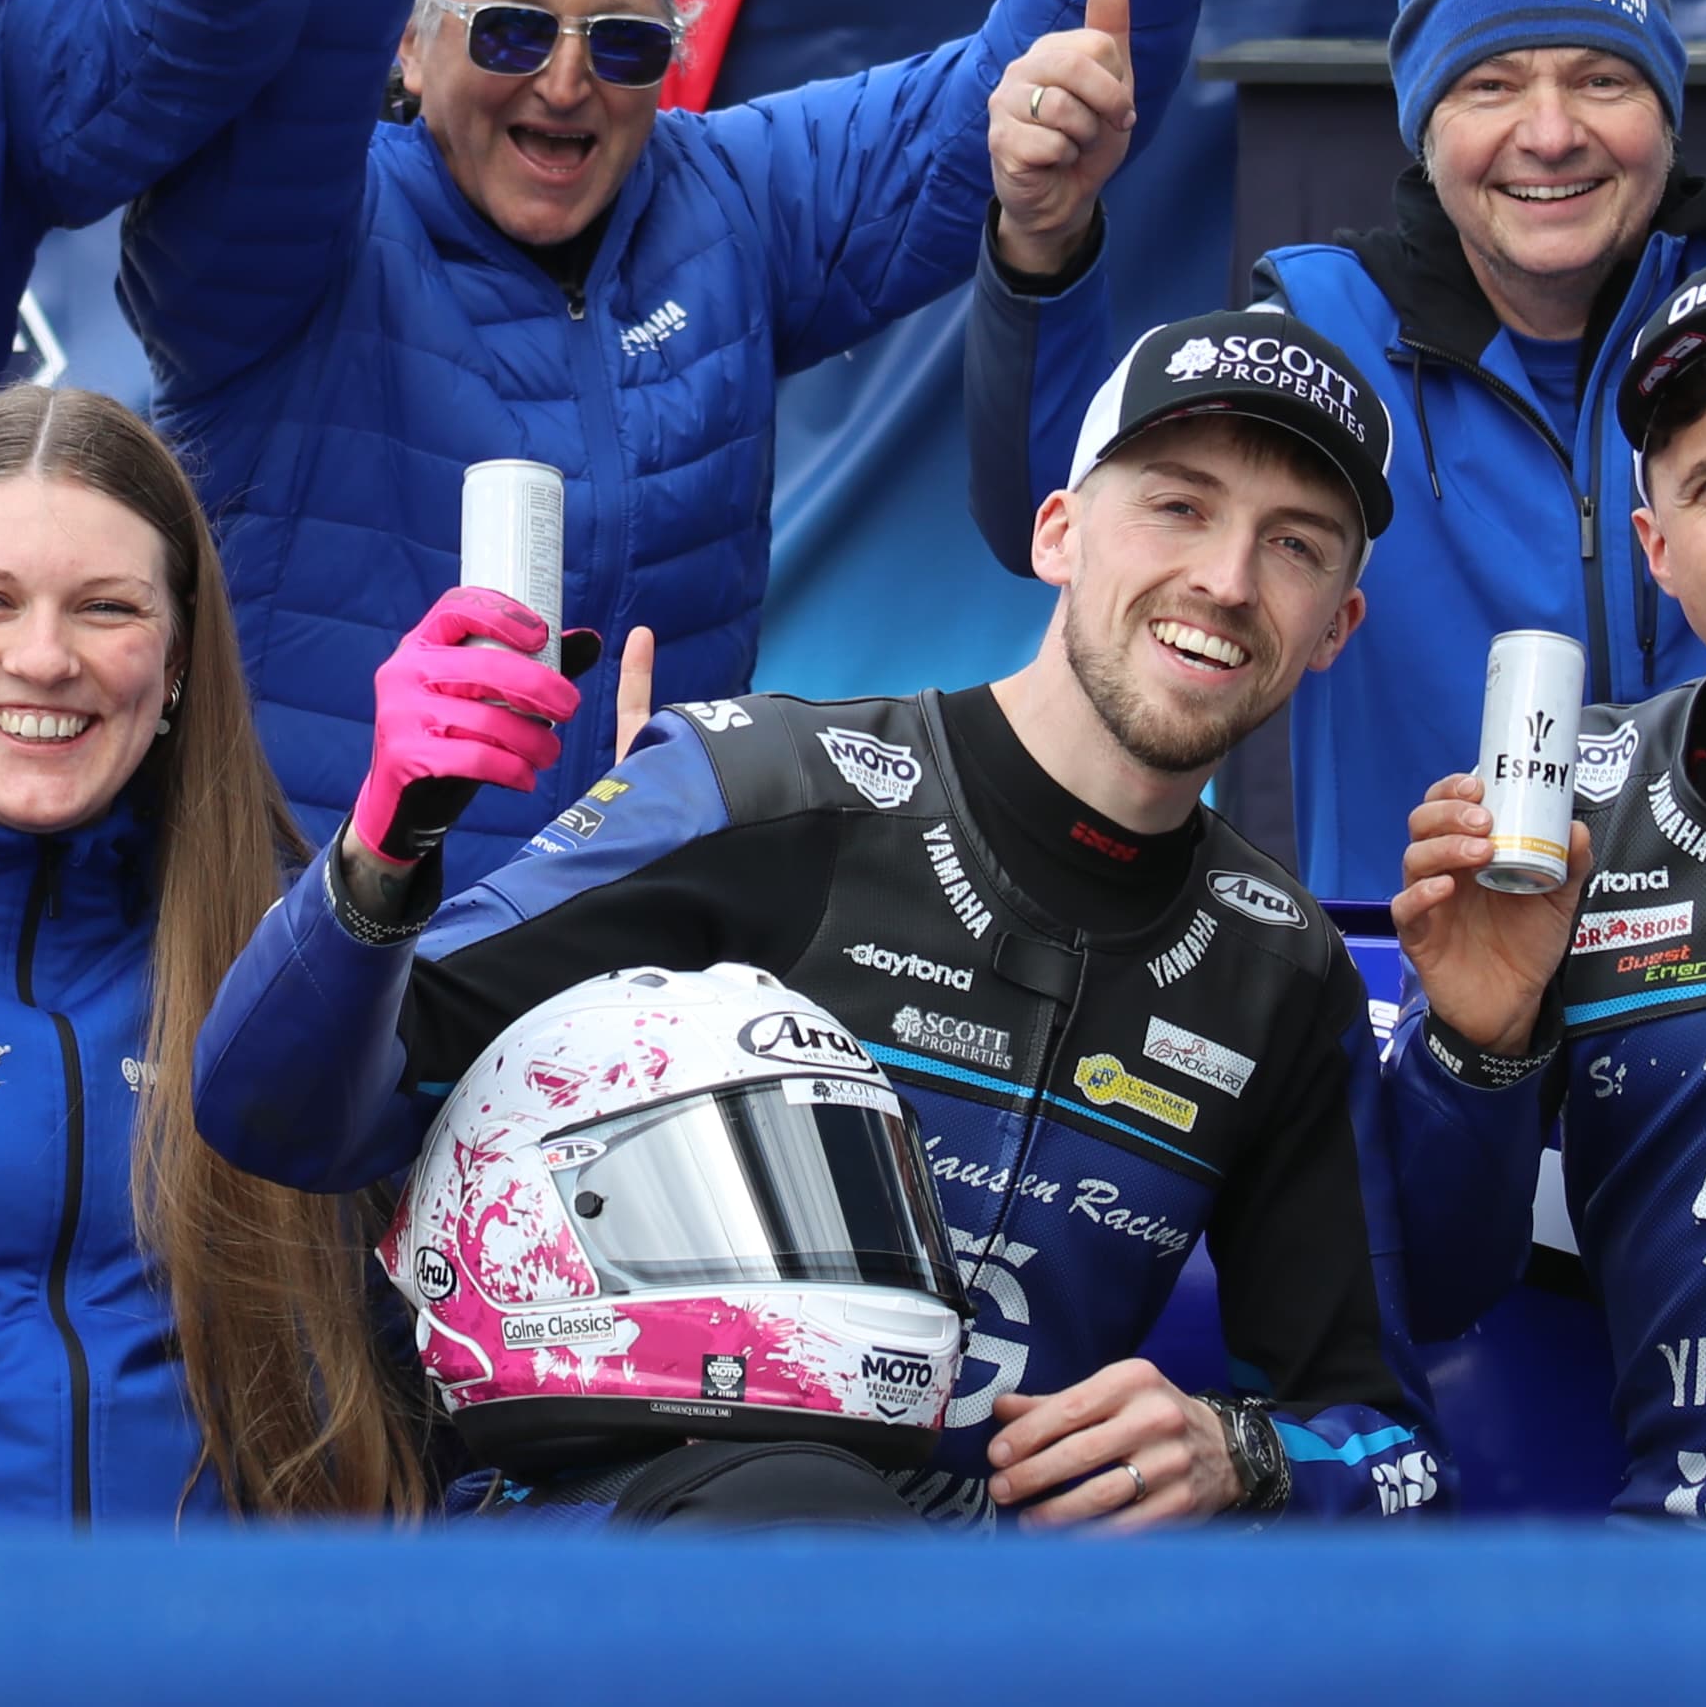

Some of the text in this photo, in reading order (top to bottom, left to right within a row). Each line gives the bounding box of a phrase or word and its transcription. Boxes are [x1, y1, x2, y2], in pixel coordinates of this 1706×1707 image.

[1219, 336, 1359, 410] SCOTT
[1215, 362, 1366, 444] PROPERTIES
[829, 740, 916, 781] MOTO
[1578, 734, 1635, 765] OTO
[922, 822, 993, 940] YAMAHA
[1213, 878, 1297, 919] Arai
[1587, 866, 1670, 898] ytona
[843, 943, 974, 992] daytona
[1146, 908, 1219, 989] YAMAHA
[920, 1032, 1013, 1071] PROPERTIES
[923, 1011, 1010, 1052] SCOTT
[1068, 1178, 1190, 1258] Racing
[418, 1251, 449, 1287] Arai
[503, 1312, 612, 1341] Colne Classics
[707, 1364, 743, 1378] MOTO
[861, 1354, 932, 1388] MOTO
